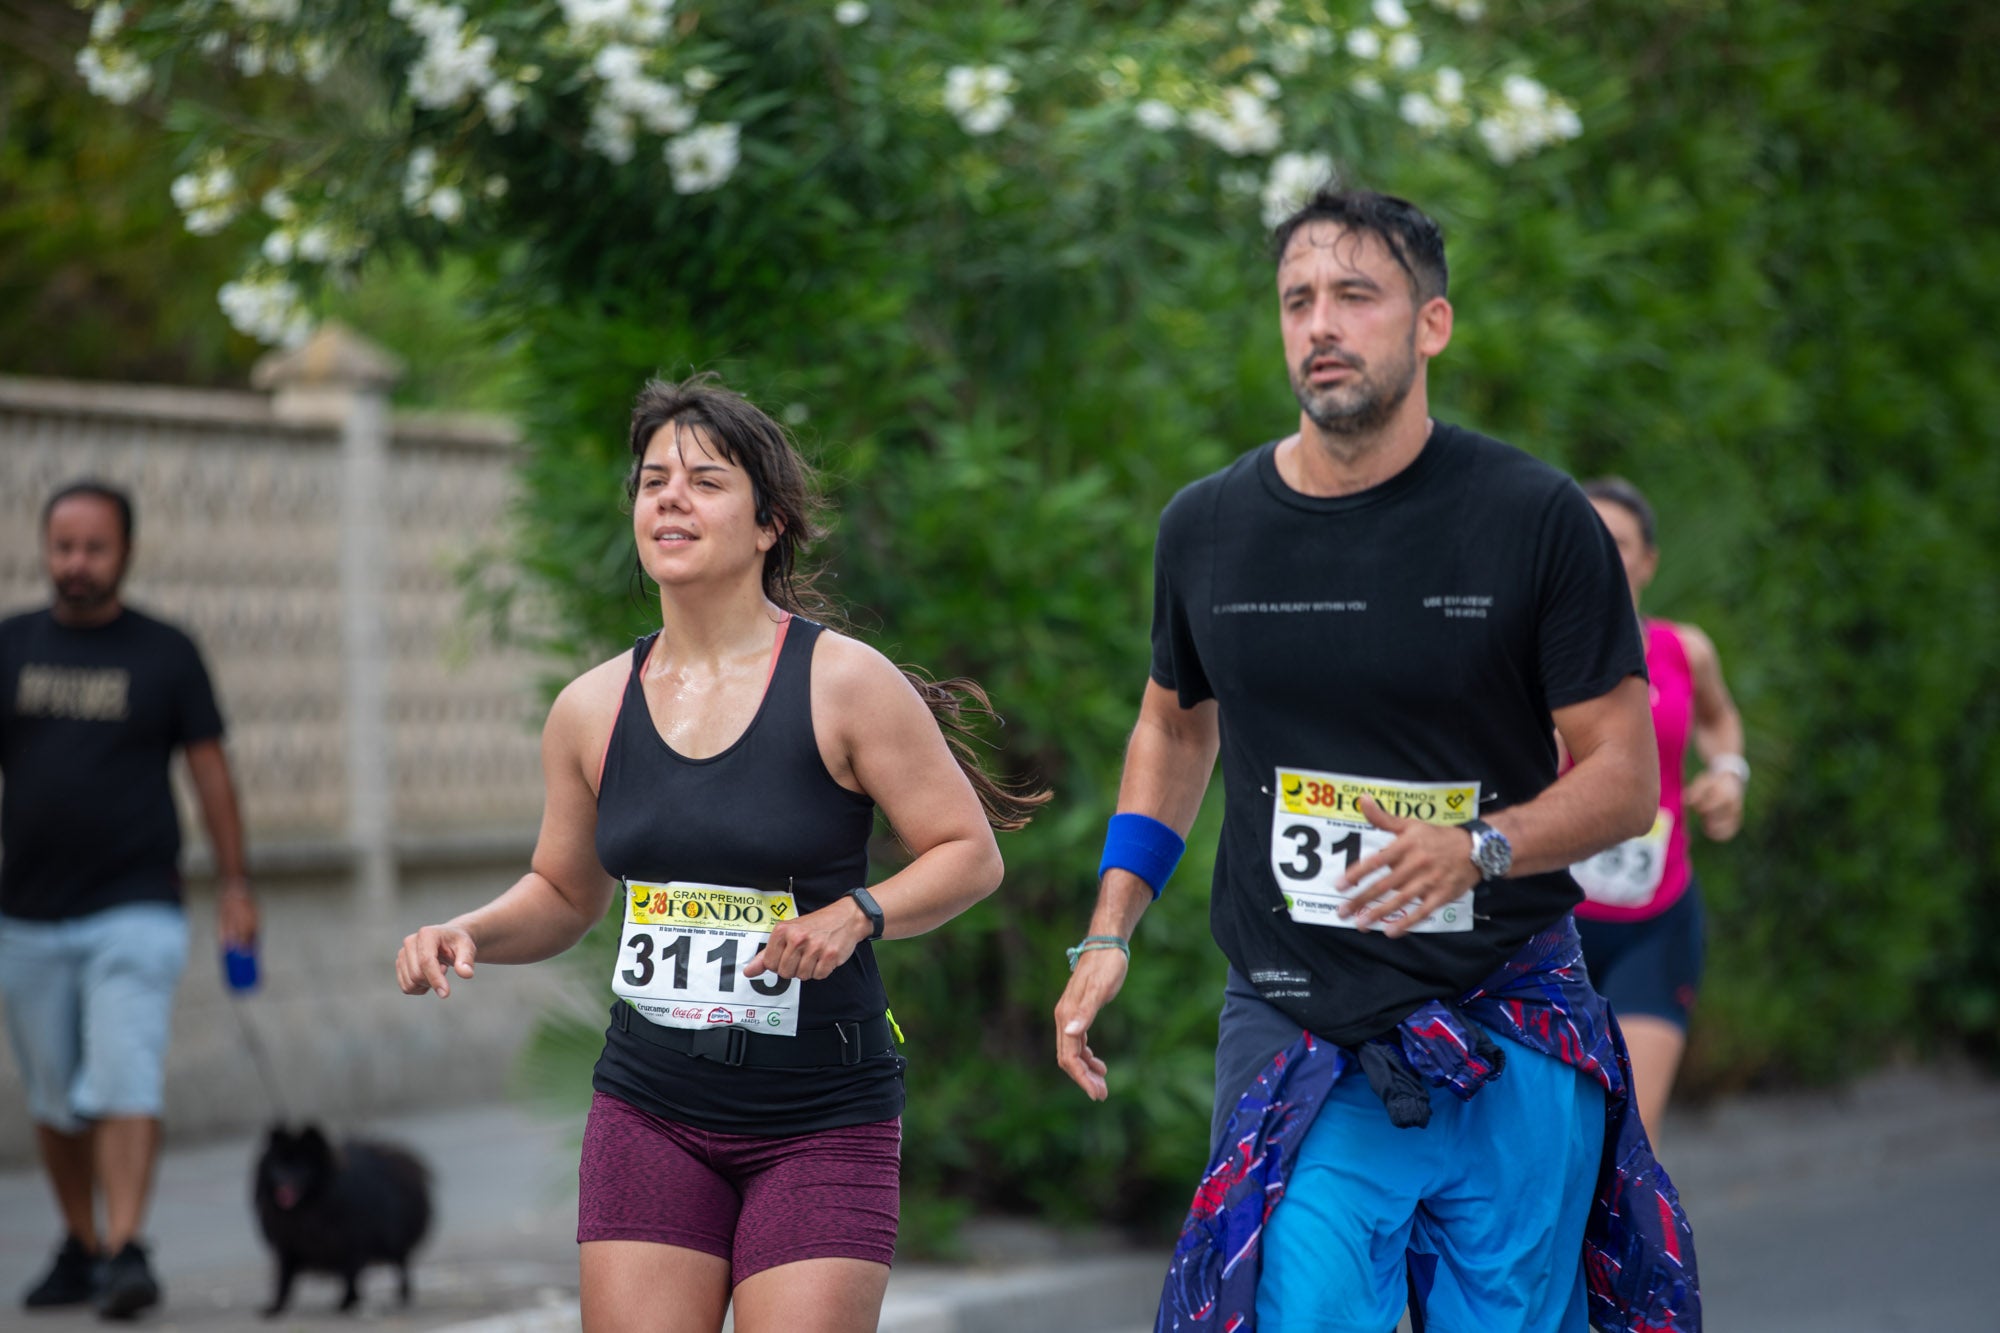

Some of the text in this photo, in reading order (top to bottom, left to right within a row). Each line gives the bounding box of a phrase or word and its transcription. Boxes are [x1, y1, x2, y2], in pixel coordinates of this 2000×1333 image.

[1347, 601, 1368, 611] YOU
[1306, 781, 1335, 807] 38
[1342, 784, 1376, 796] GRAN
[1380, 788, 1428, 800] PREMIO
[649, 892, 668, 915] 38
[673, 890, 707, 901] GRAN
[710, 893, 755, 906] PREMIO
[668, 899, 764, 924] FONDO
[637, 1003, 670, 1014] Cruzcampo
